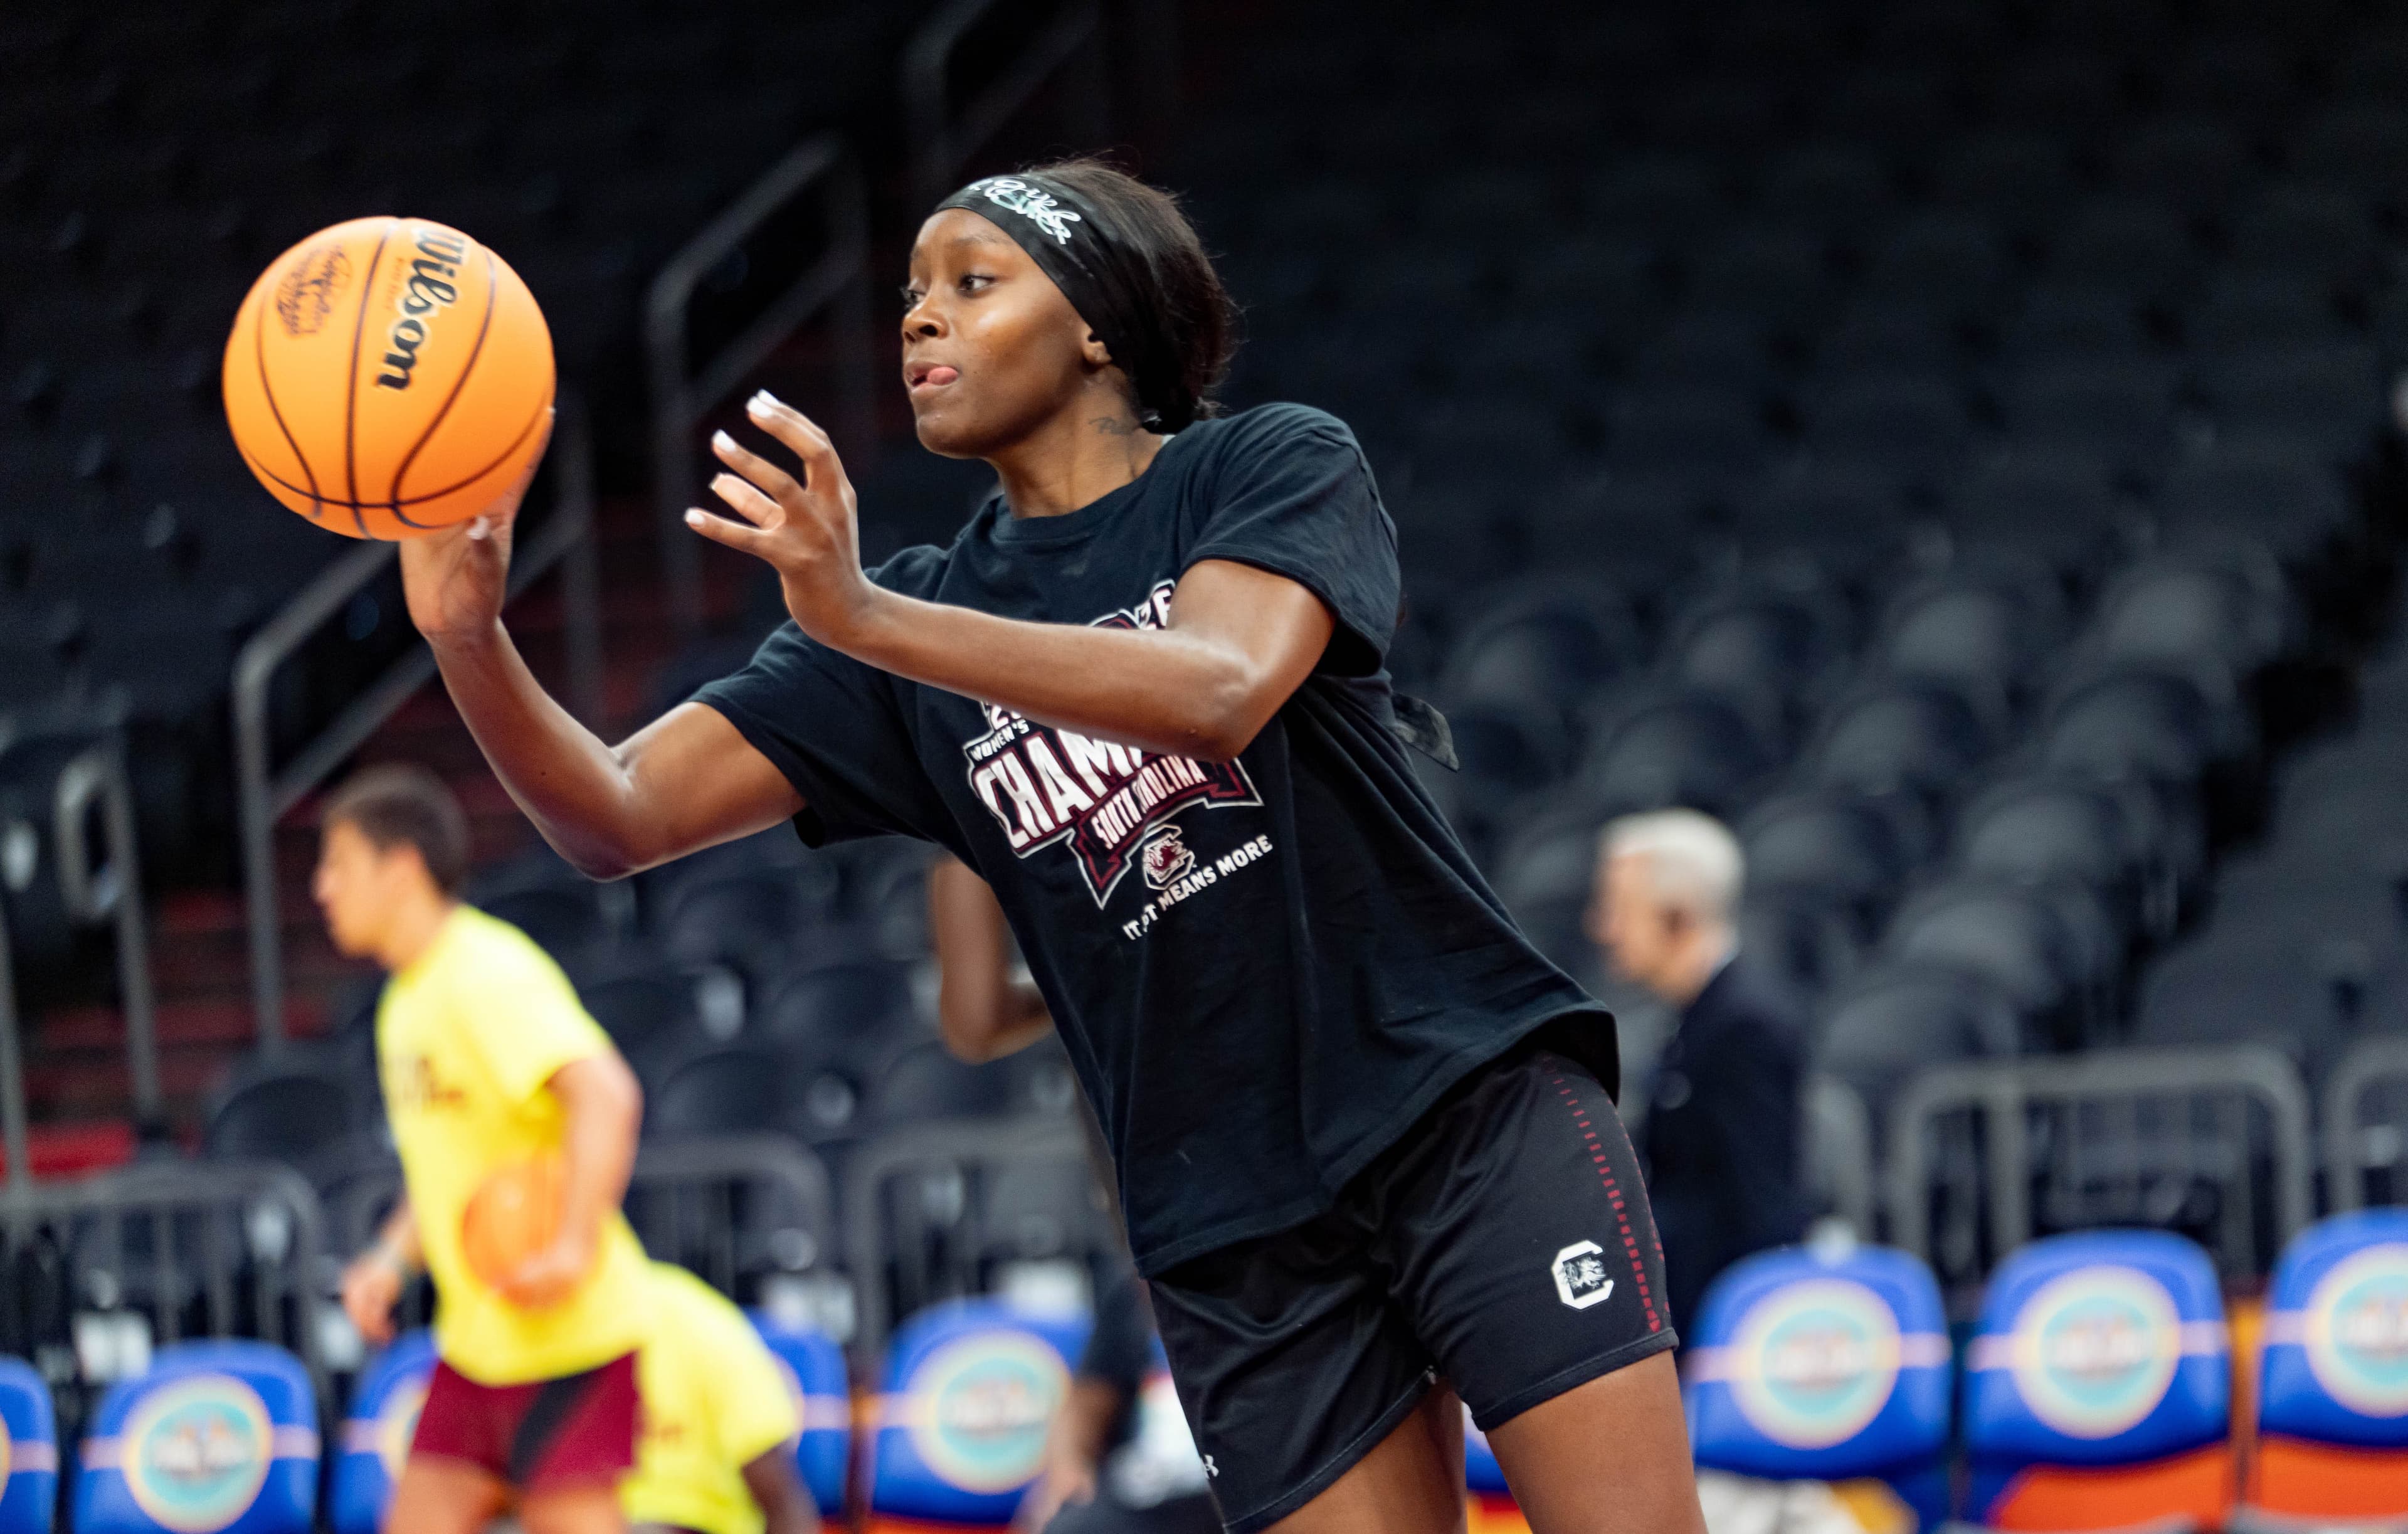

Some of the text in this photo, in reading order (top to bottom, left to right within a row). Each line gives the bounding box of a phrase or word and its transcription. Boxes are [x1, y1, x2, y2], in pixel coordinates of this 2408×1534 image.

[378, 228, 465, 389] Wilson
[975, 727, 1143, 849] CHAM
[1091, 787, 1143, 850] SOUTH
[1122, 834, 1273, 940] IT MEANS MORE
